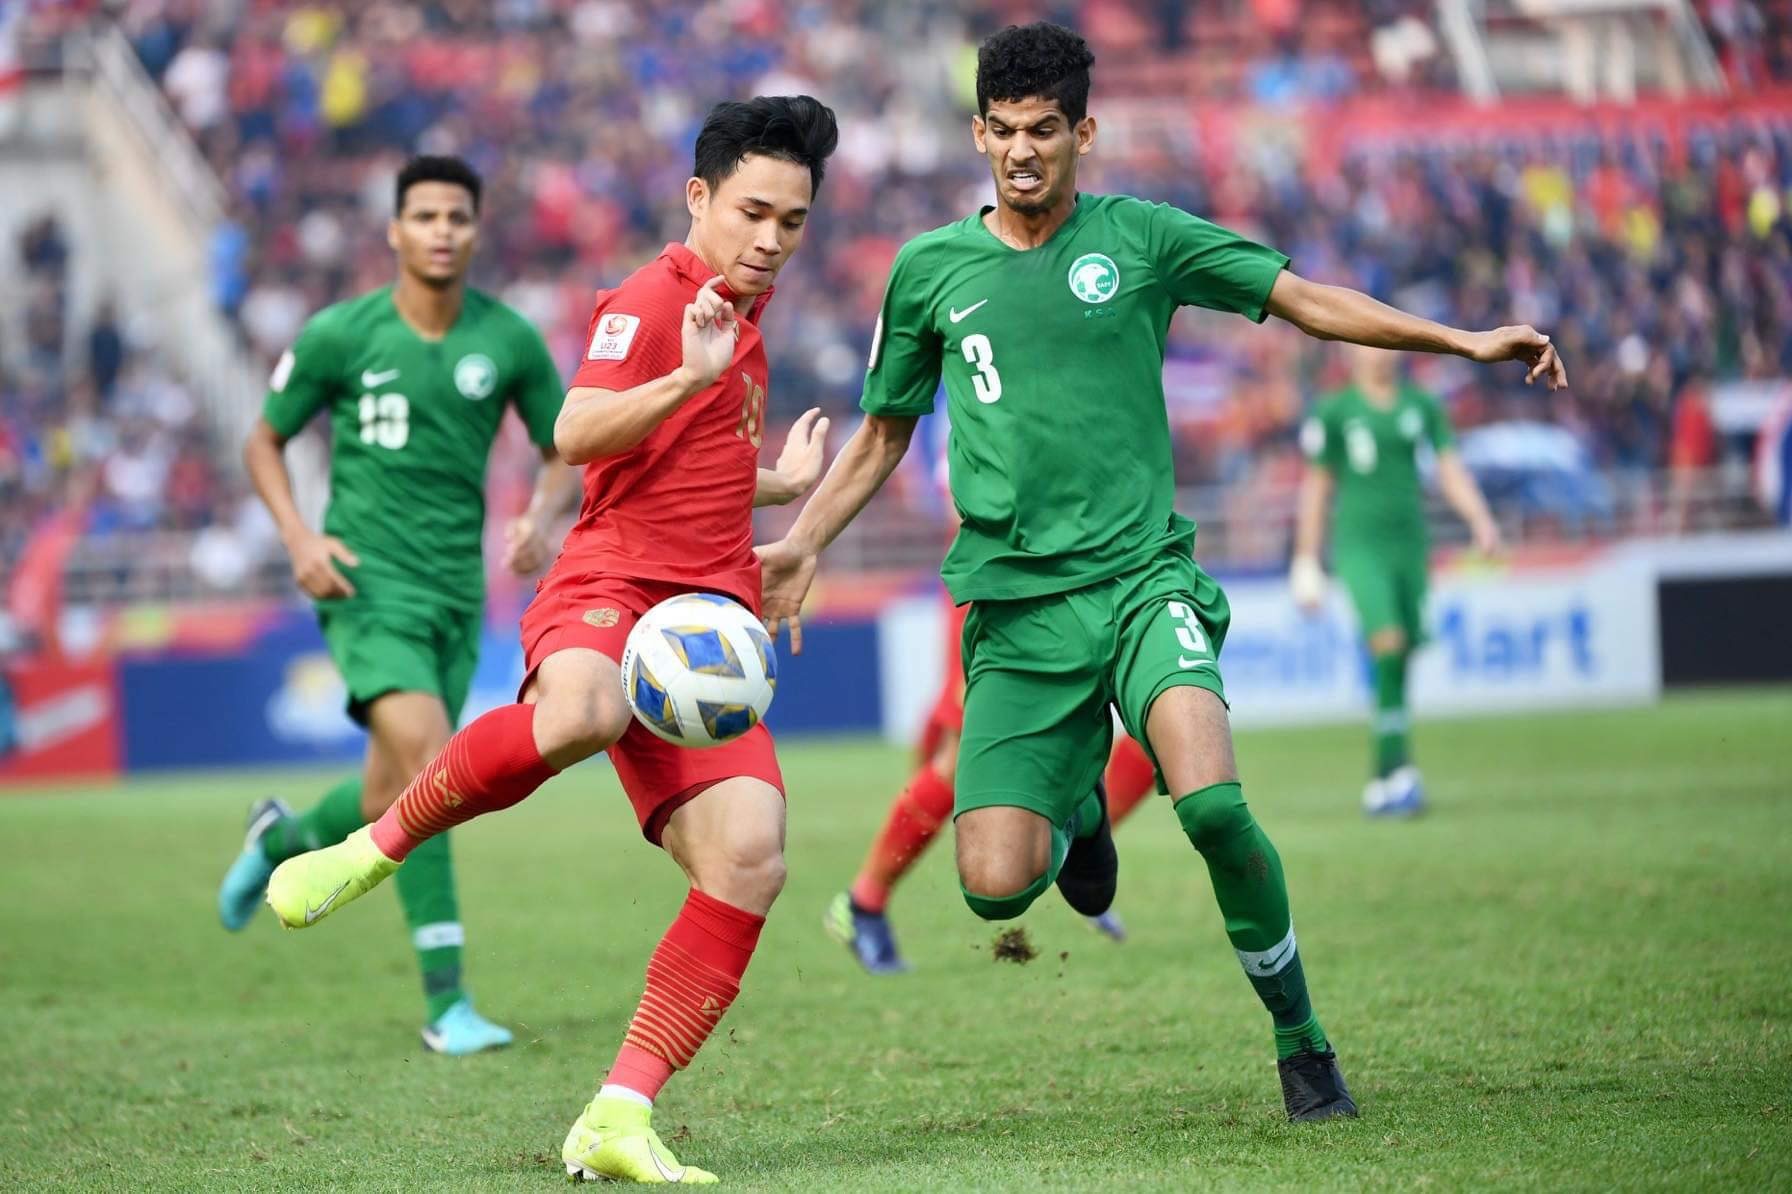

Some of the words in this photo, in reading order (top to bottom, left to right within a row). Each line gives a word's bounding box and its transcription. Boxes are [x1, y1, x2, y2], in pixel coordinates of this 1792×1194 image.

[600, 342, 618, 350] U23
[961, 333, 1002, 404] 3
[358, 393, 409, 450] 13
[736, 371, 765, 449] 10
[1168, 601, 1207, 653] 3
